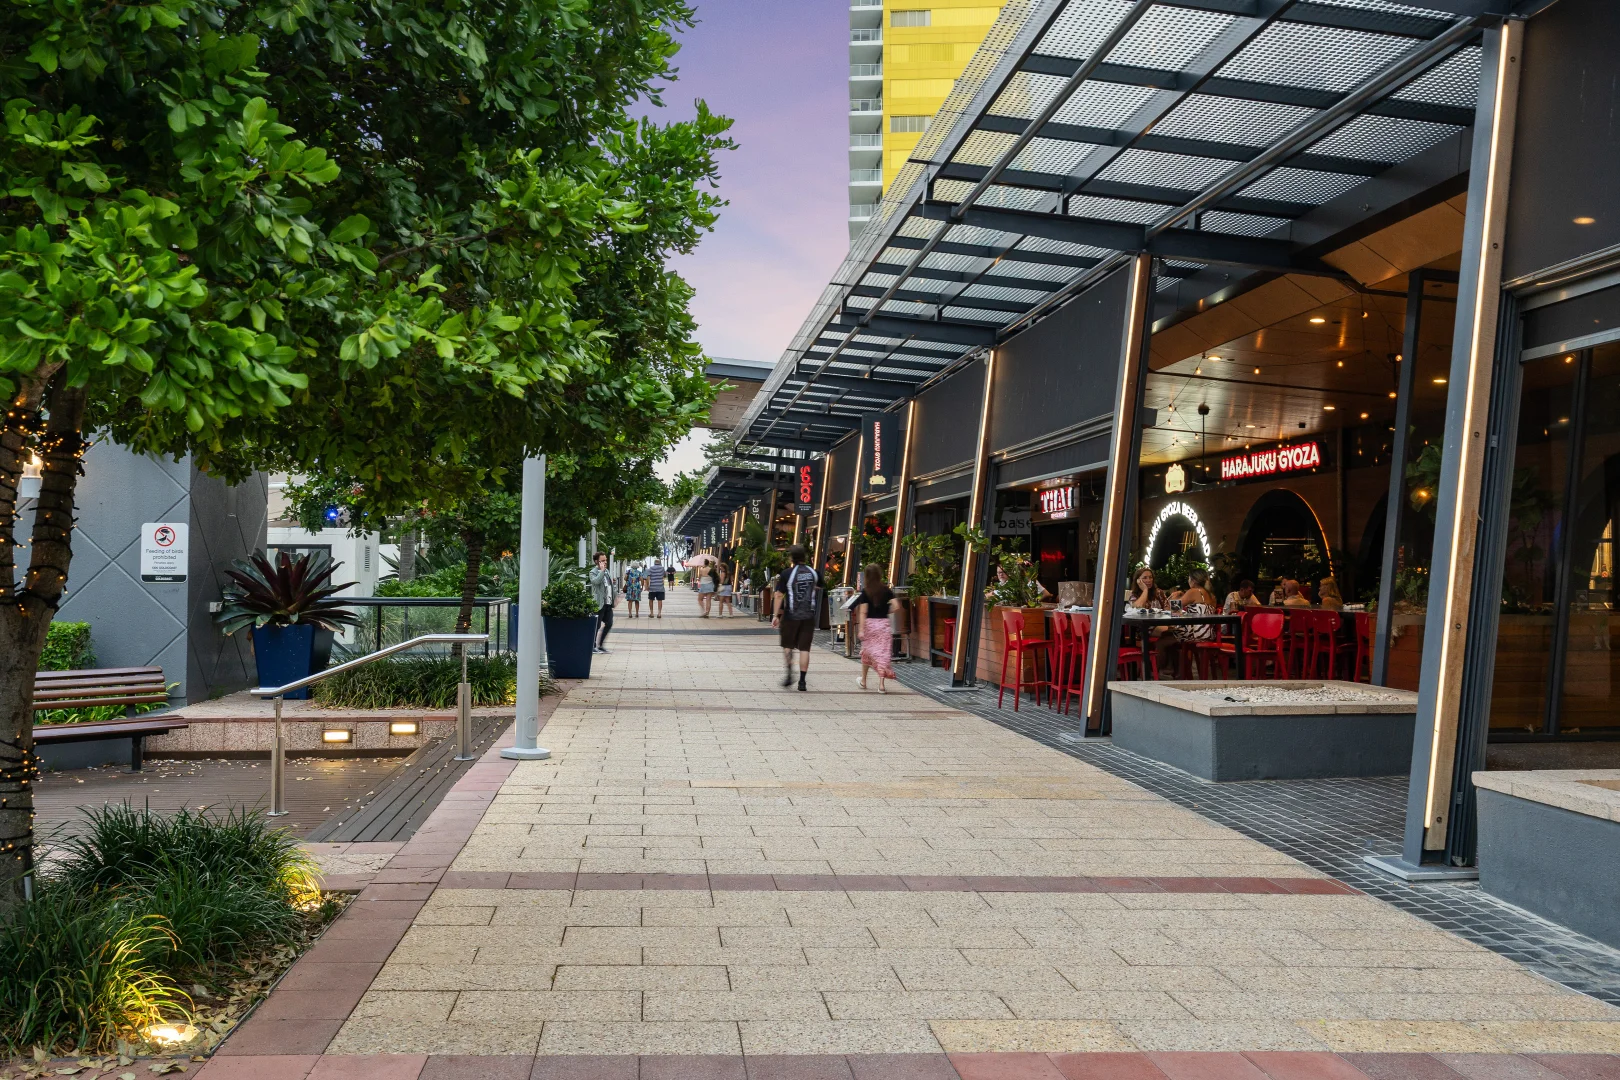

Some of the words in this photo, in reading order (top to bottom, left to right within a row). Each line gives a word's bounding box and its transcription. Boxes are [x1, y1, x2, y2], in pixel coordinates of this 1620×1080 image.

[873, 421, 881, 452] HARAJUKU
[873, 452, 881, 471] GYOZA
[1221, 450, 1276, 479] HARAJUKU
[1279, 443, 1319, 470] GYOZA
[1040, 485, 1074, 514] THAI
[1161, 501, 1181, 522] GYOZA
[1181, 502, 1199, 527] BEER
